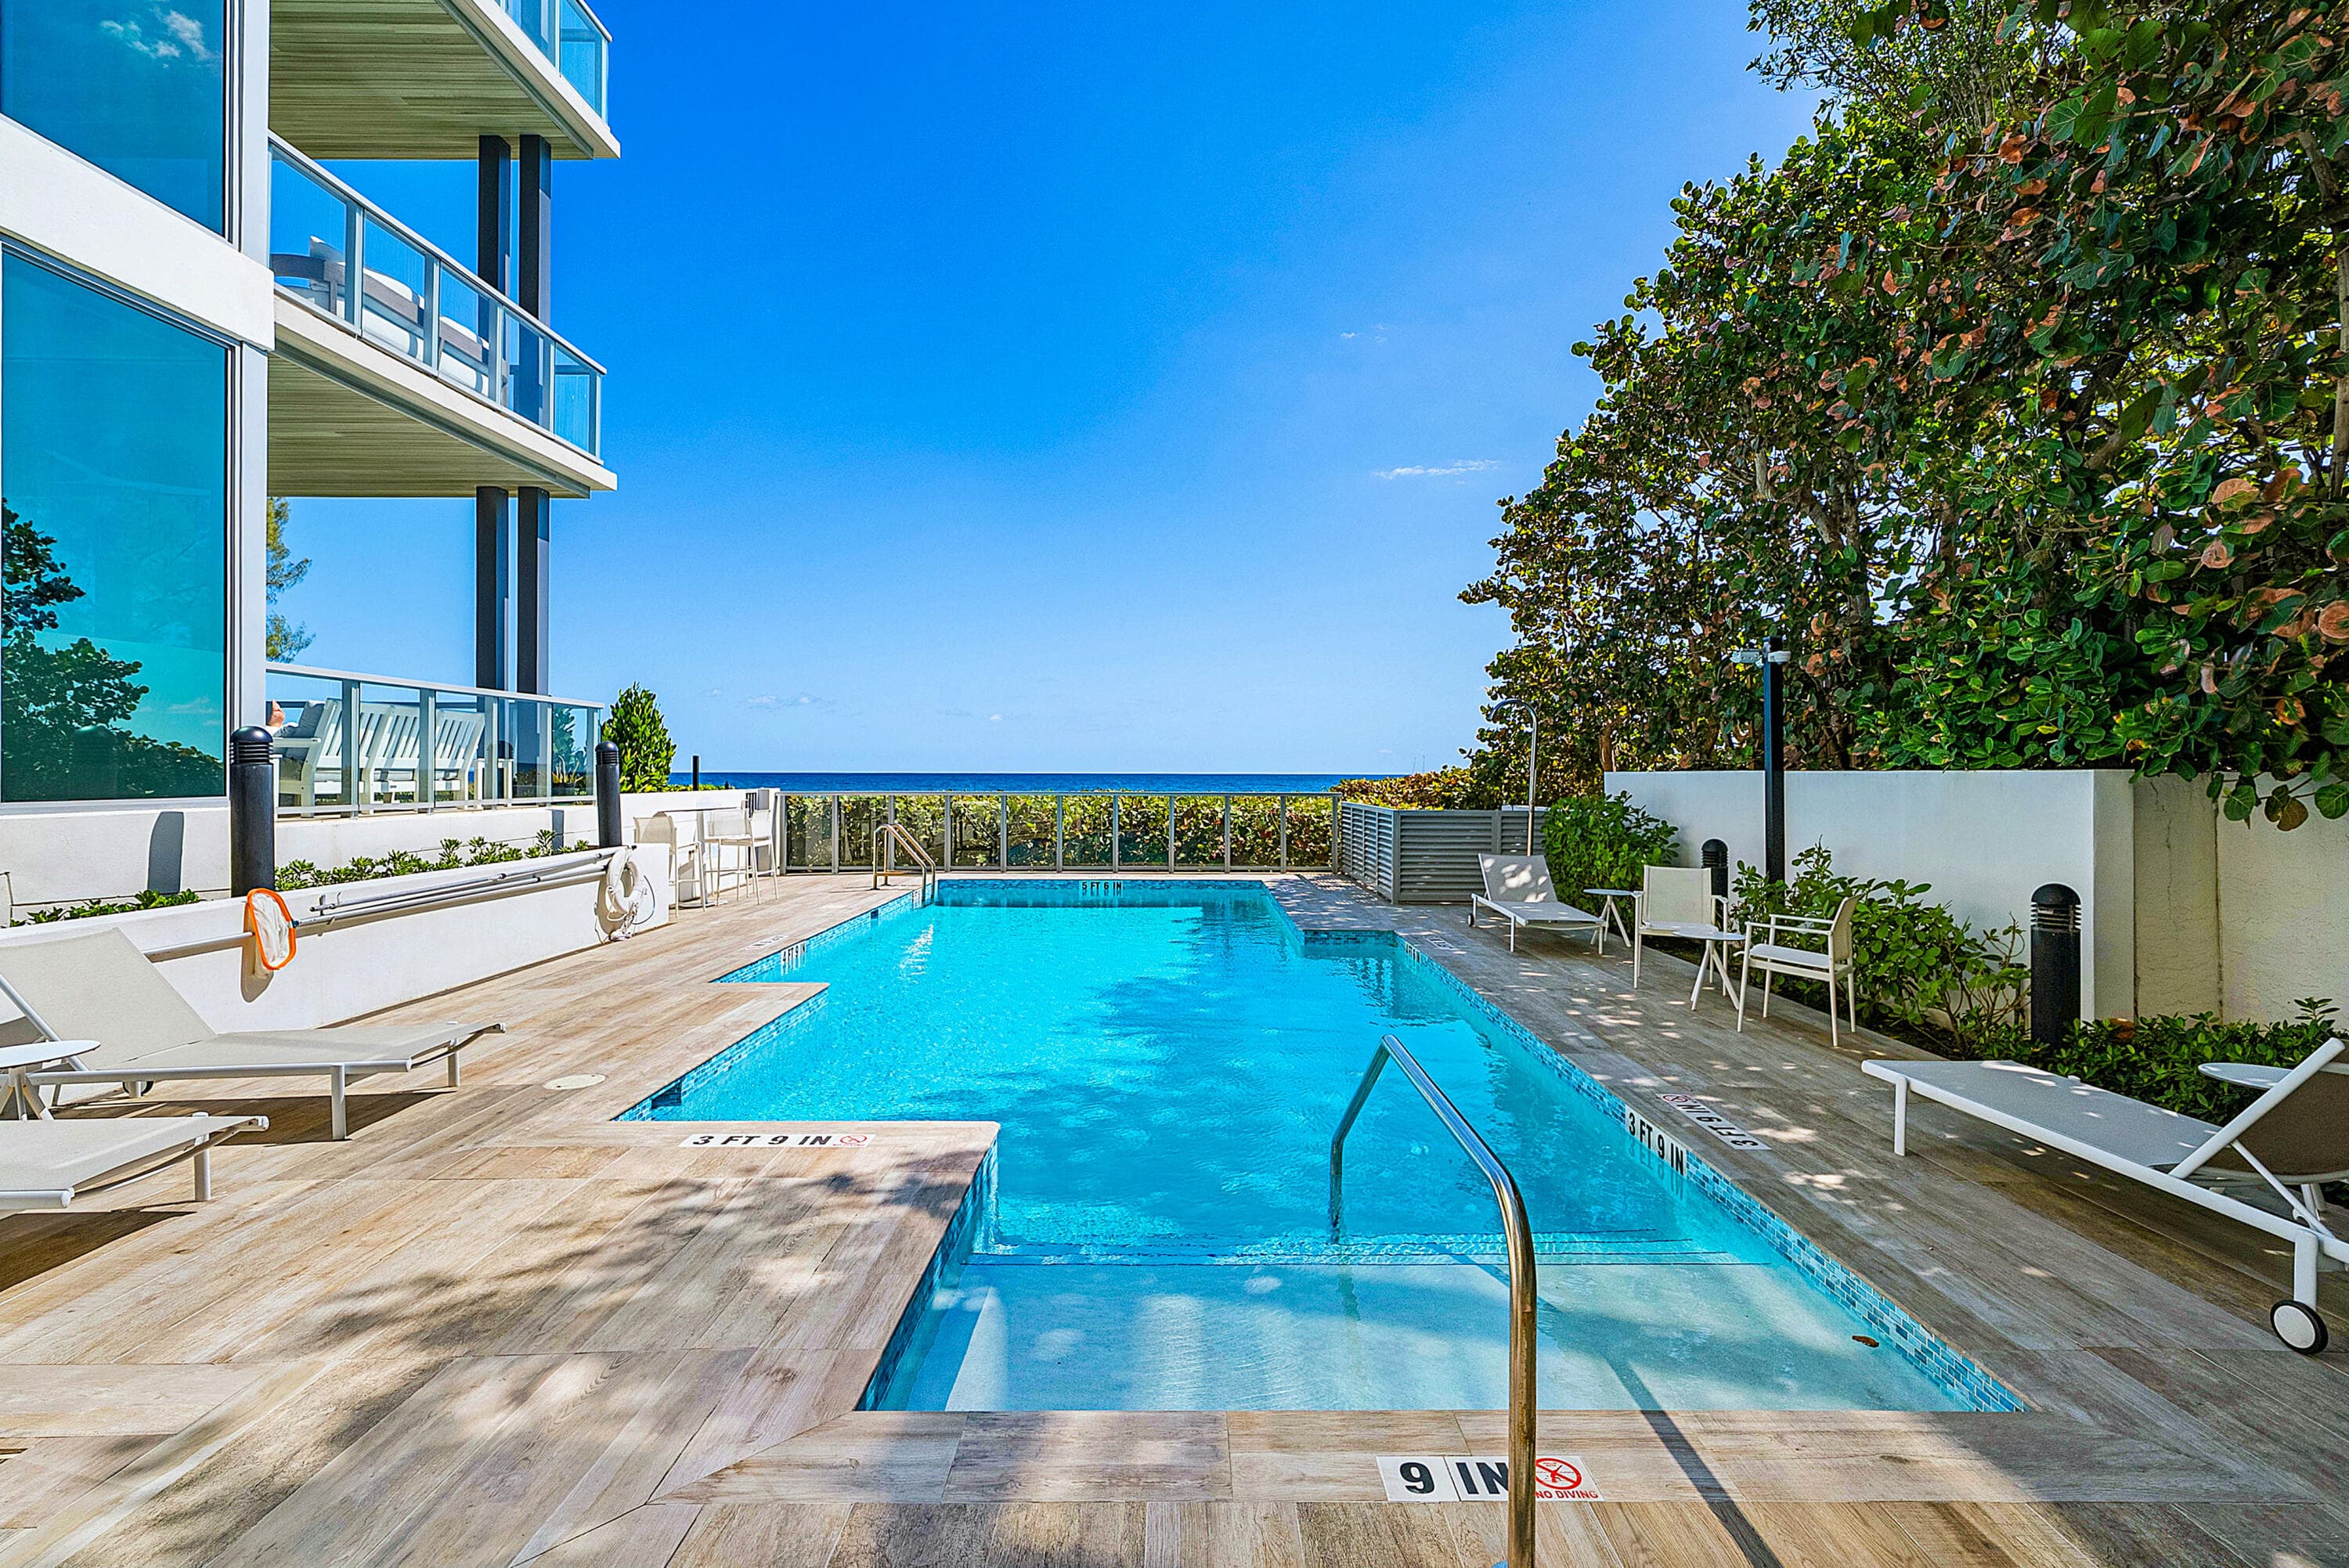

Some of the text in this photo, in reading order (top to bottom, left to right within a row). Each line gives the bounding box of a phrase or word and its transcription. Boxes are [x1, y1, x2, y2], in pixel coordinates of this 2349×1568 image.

[1676, 1104, 1711, 1113] IN
[1708, 1125, 1746, 1137] FT
[693, 1135, 832, 1145] 3 FT 9 IN
[1629, 1112, 1683, 1175] 3 FT 9 IN
[1399, 1462, 1509, 1494] 9 IN
[1535, 1490, 1599, 1498] NO DIVING
